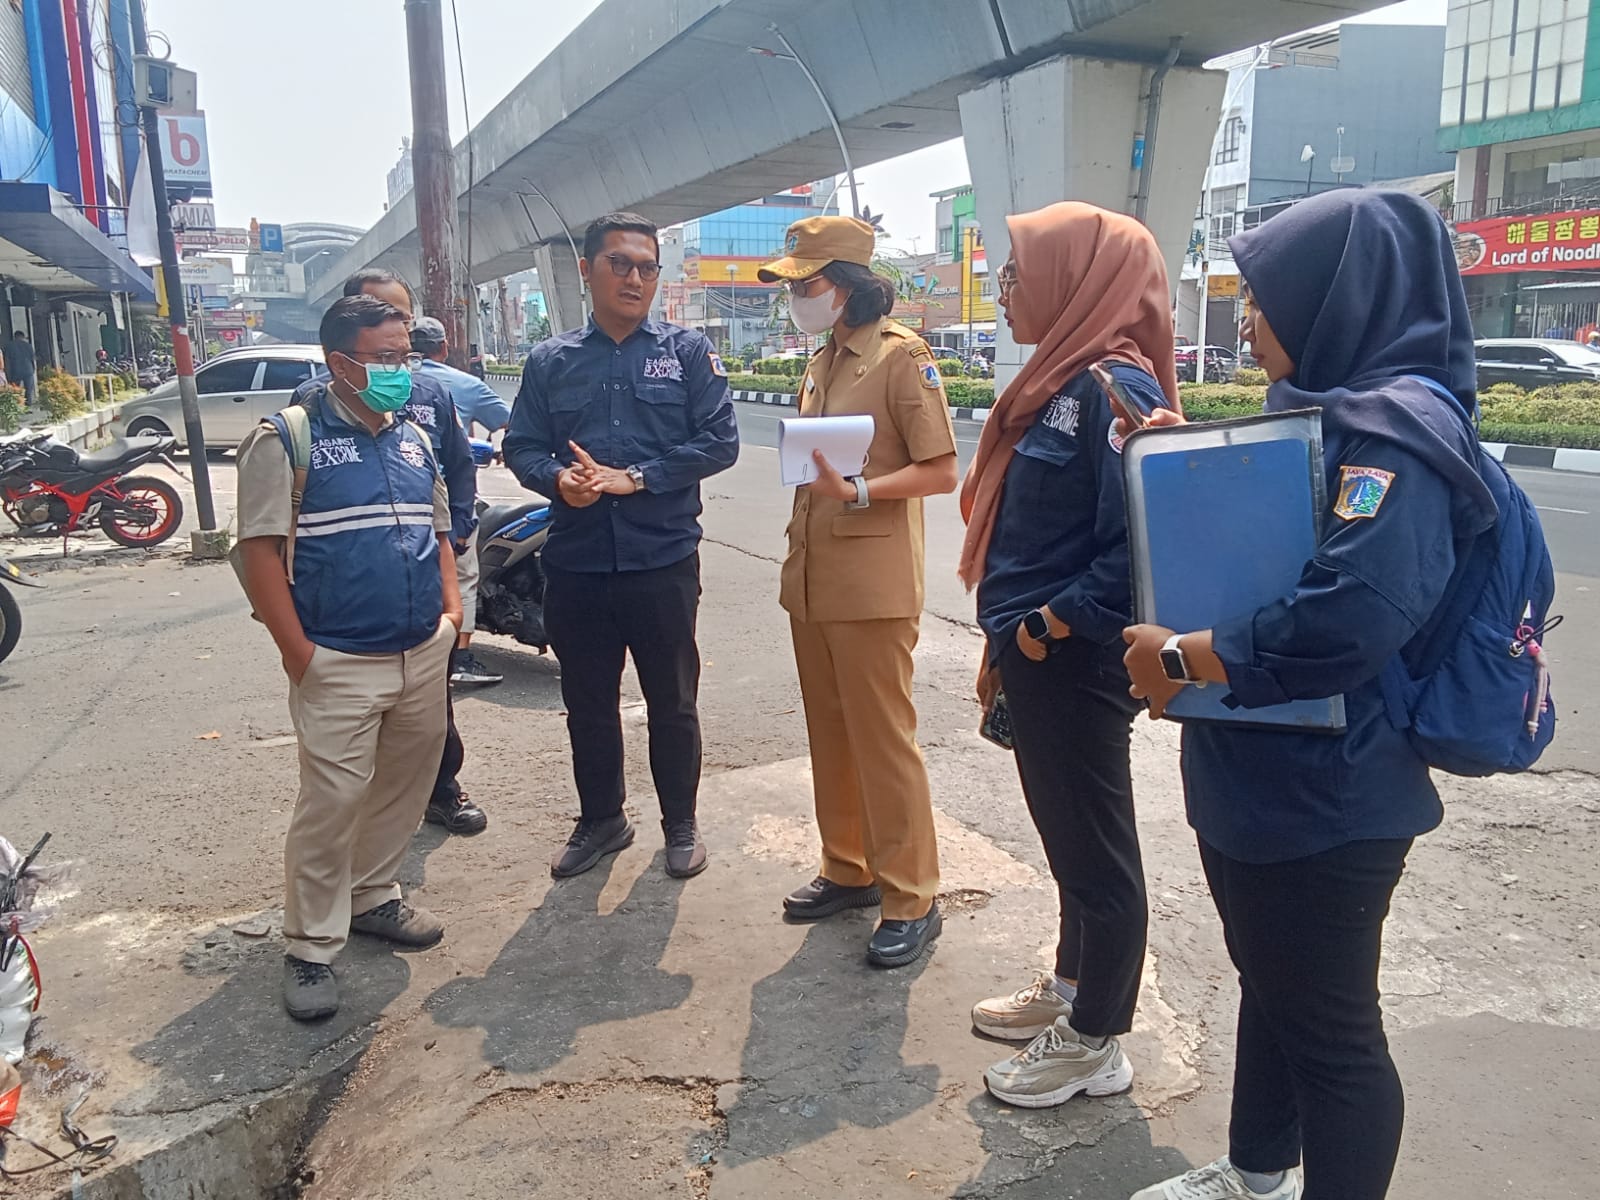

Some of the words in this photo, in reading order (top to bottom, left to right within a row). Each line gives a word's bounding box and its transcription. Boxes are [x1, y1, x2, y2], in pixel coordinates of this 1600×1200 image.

[265, 227, 277, 247] P
[1492, 249, 1527, 266] Lord
[1531, 246, 1549, 263] of
[319, 437, 355, 447] AGAINST
